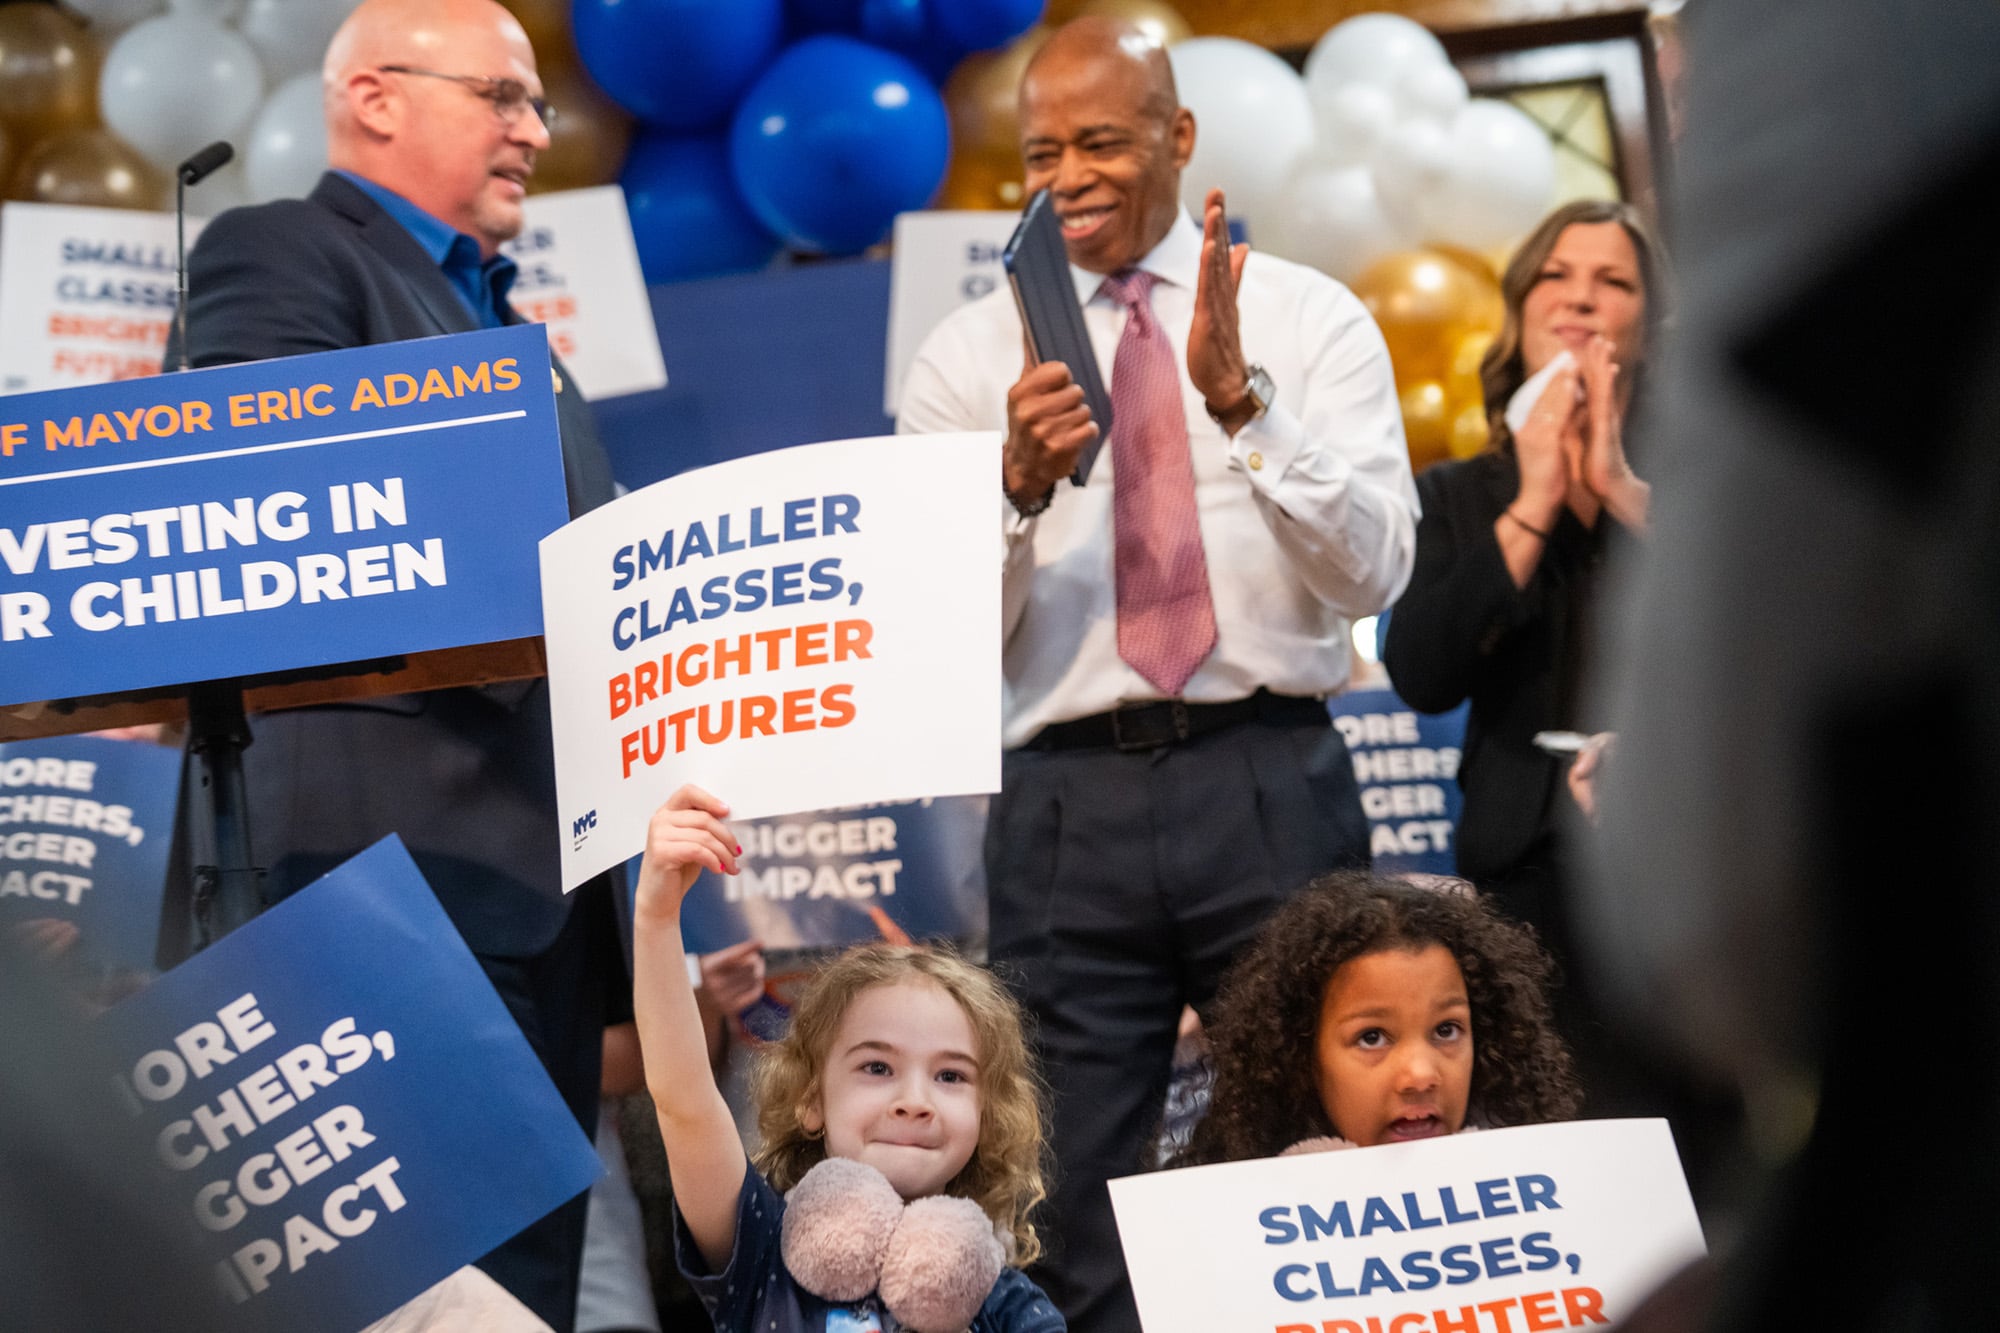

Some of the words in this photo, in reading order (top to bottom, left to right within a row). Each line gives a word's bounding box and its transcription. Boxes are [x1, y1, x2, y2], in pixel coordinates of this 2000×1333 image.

[44, 401, 213, 451] MAYOR
[229, 384, 336, 428] ERIC
[350, 358, 521, 411] ADAMS
[329, 477, 407, 533] IN
[612, 493, 861, 591] SMALLER
[70, 538, 447, 632] CHILDREN
[612, 558, 864, 651] CLASSES,
[609, 619, 874, 720] BRIGHTER
[621, 684, 857, 779] FUTURES
[573, 809, 597, 838] NYC
[1258, 1174, 1564, 1244] SMALLER
[1273, 1231, 1582, 1302] CLASSES,
